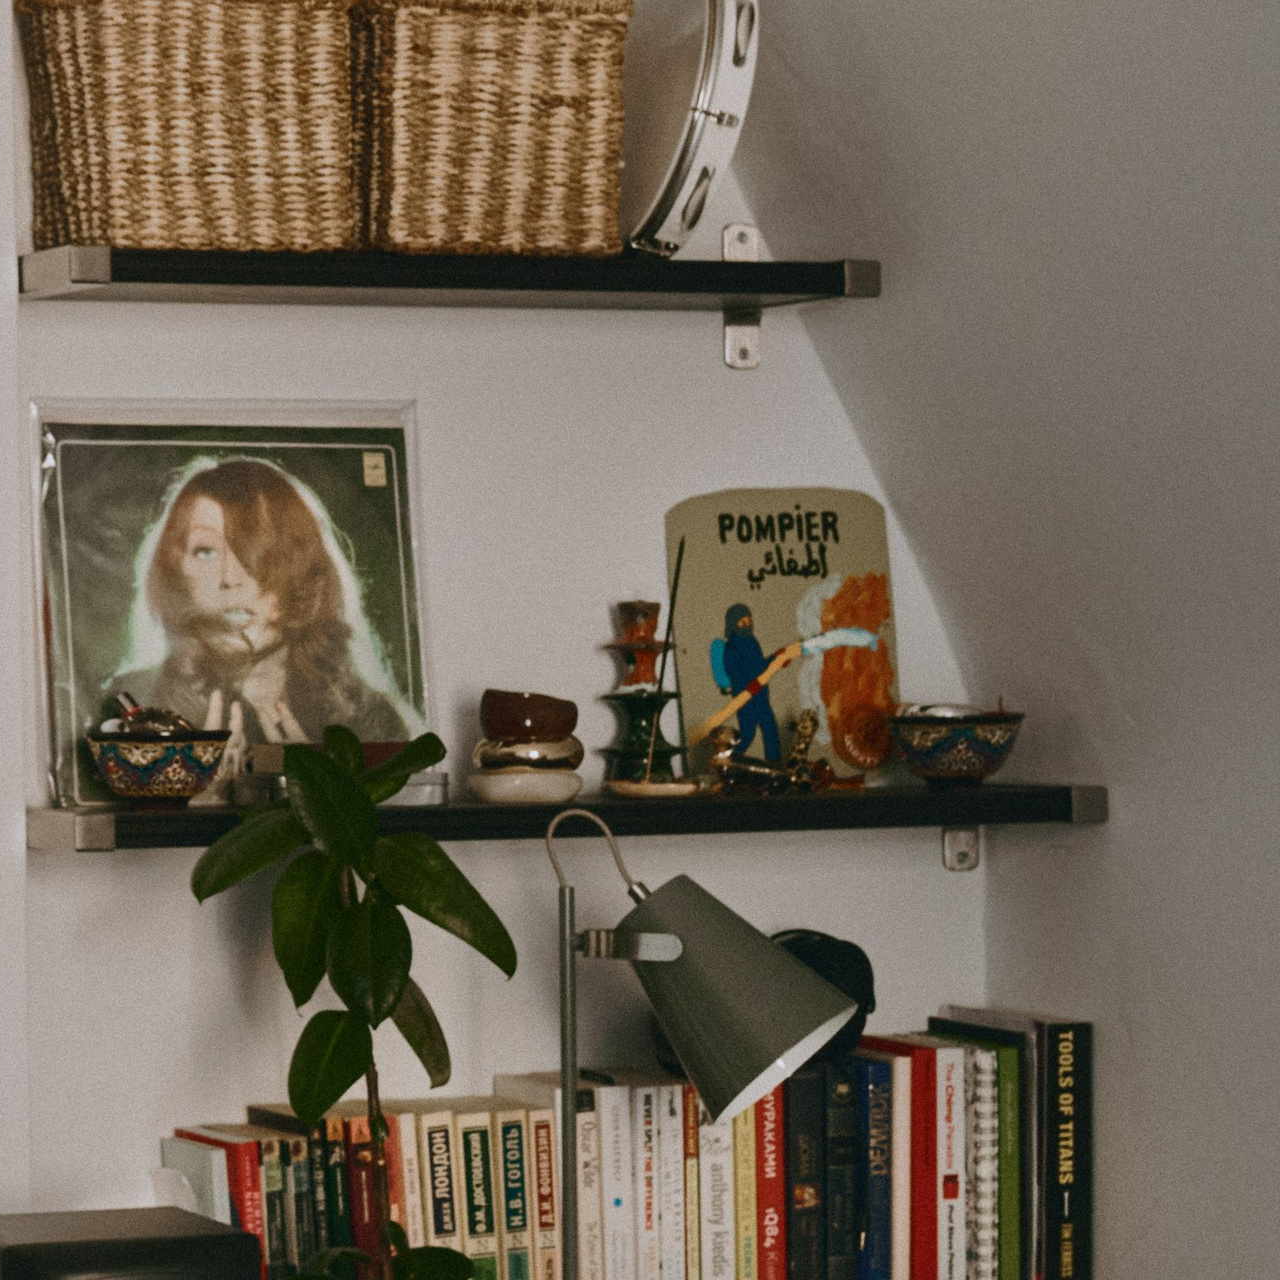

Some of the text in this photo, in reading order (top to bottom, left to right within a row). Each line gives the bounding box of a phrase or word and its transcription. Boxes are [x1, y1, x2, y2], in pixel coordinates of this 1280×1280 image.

[643, 1093, 654, 1126] NEVER
[1058, 1031, 1073, 1185] TOOLS OF TITANS
[431, 1131, 451, 1199] ЛОНДОН
[467, 1132, 488, 1206] ДОСТОЕВСКИЙ
[506, 1128, 521, 1188] ГОГОЛЬ
[708, 1163, 729, 1277] anthony kiedis
